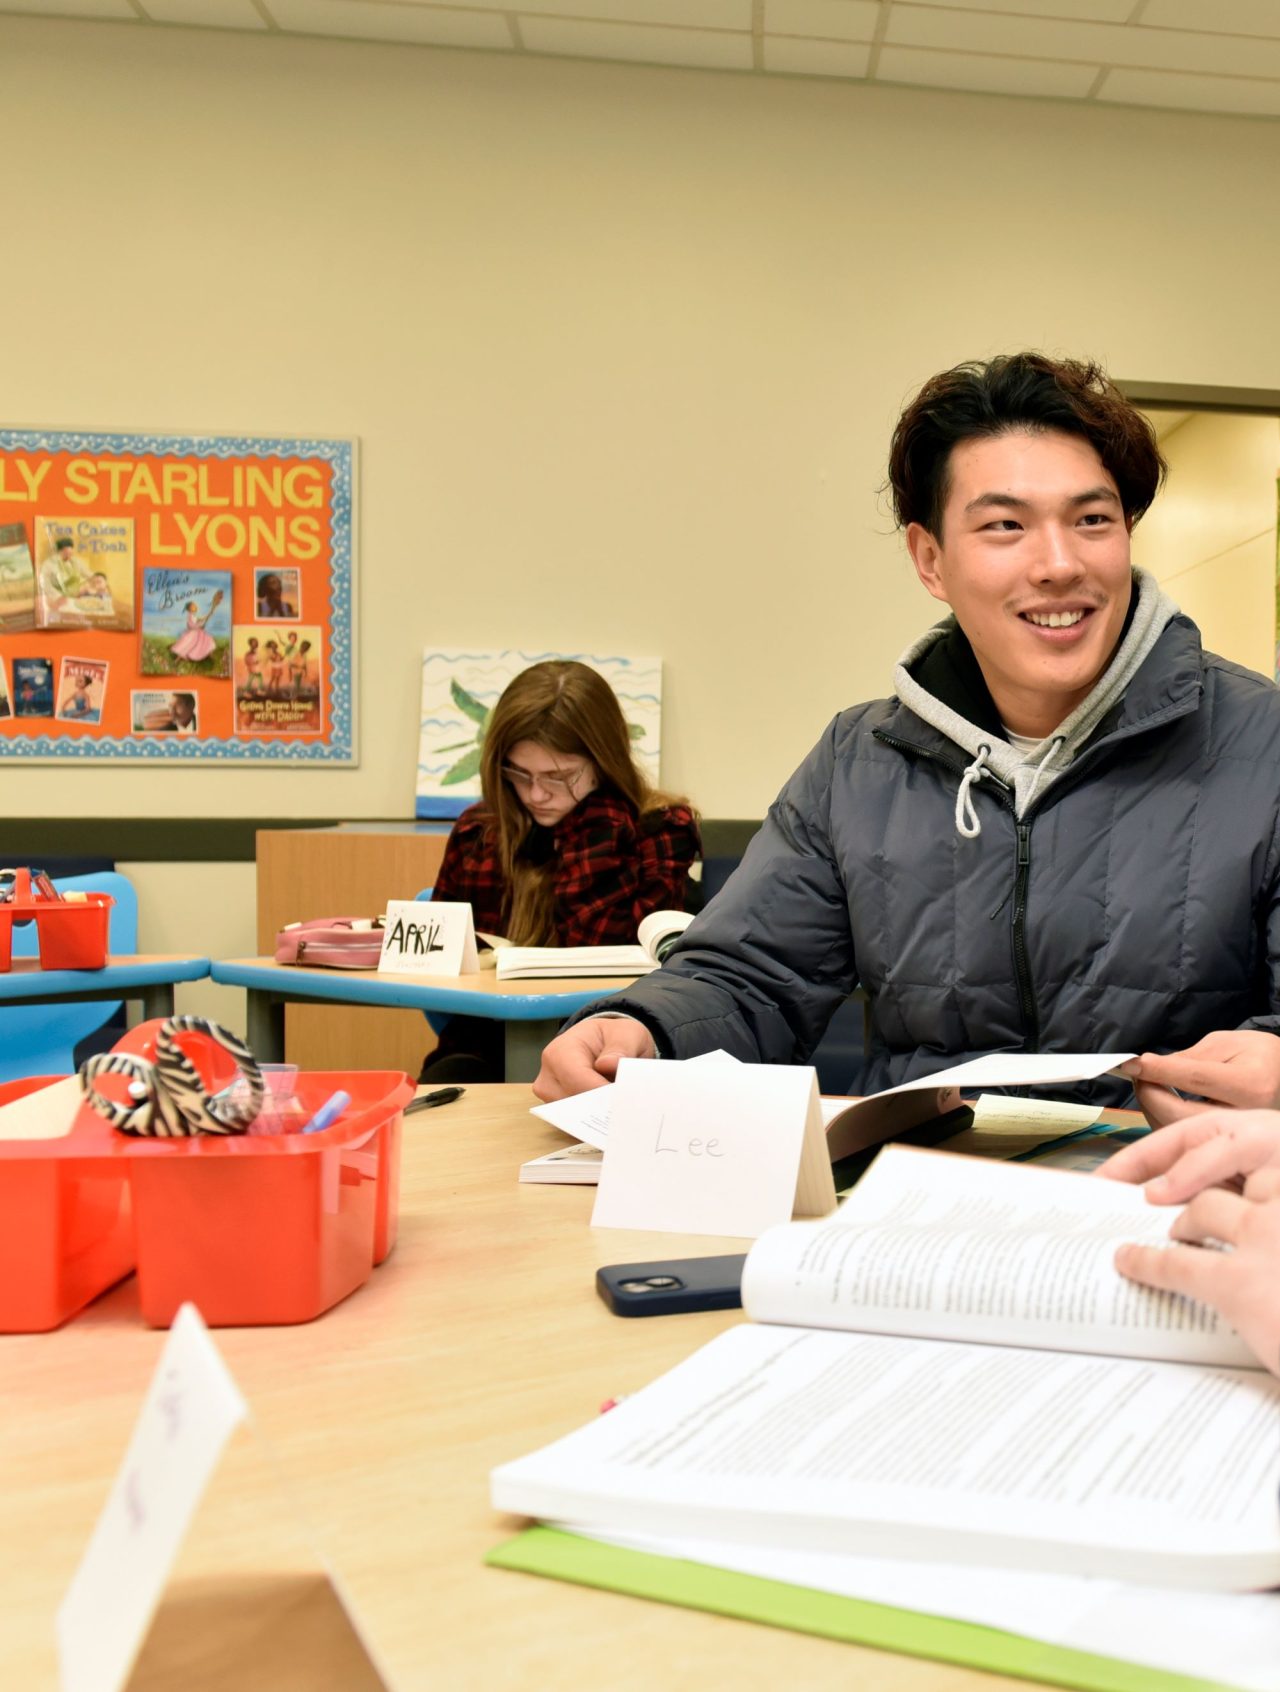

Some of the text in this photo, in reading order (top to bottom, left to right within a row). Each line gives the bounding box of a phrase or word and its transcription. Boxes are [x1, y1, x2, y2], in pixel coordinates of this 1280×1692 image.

[0, 459, 323, 508] LY STARLING
[151, 512, 321, 559] LYONS
[159, 586, 208, 610] Broom
[655, 1113, 725, 1158] Lee
